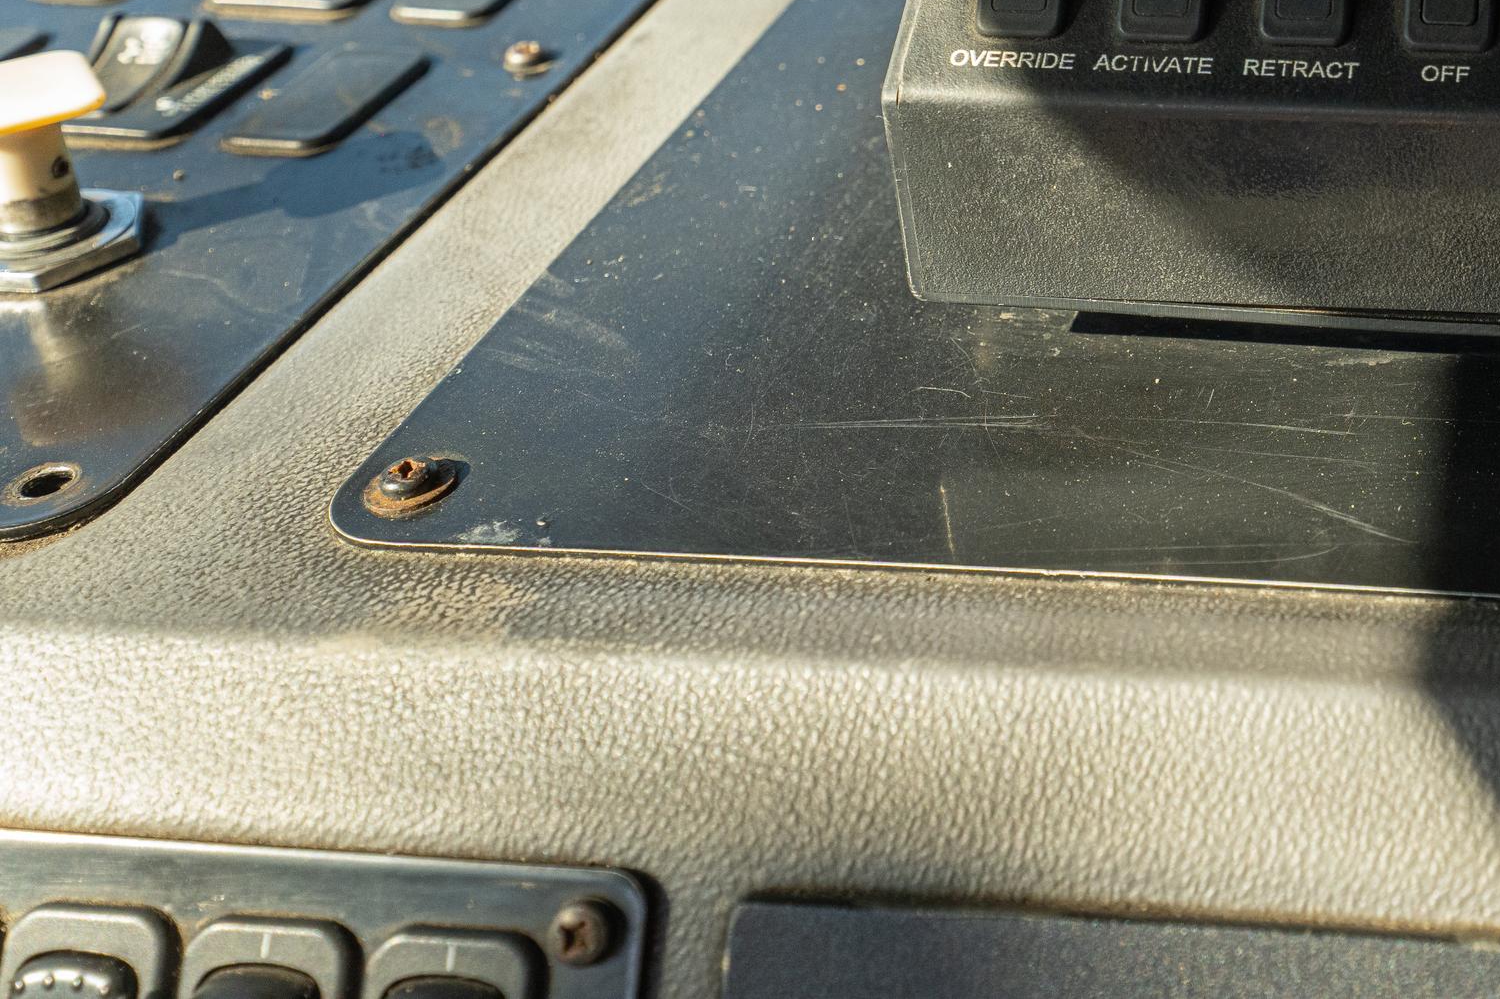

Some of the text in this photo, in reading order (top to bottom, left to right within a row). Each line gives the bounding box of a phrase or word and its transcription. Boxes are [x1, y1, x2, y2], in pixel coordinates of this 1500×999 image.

[949, 49, 1076, 71] OVERRIDE
[1093, 54, 1213, 74] ACTIVATE
[1243, 59, 1359, 78] RETRACT
[1421, 65, 1470, 82] OFF
